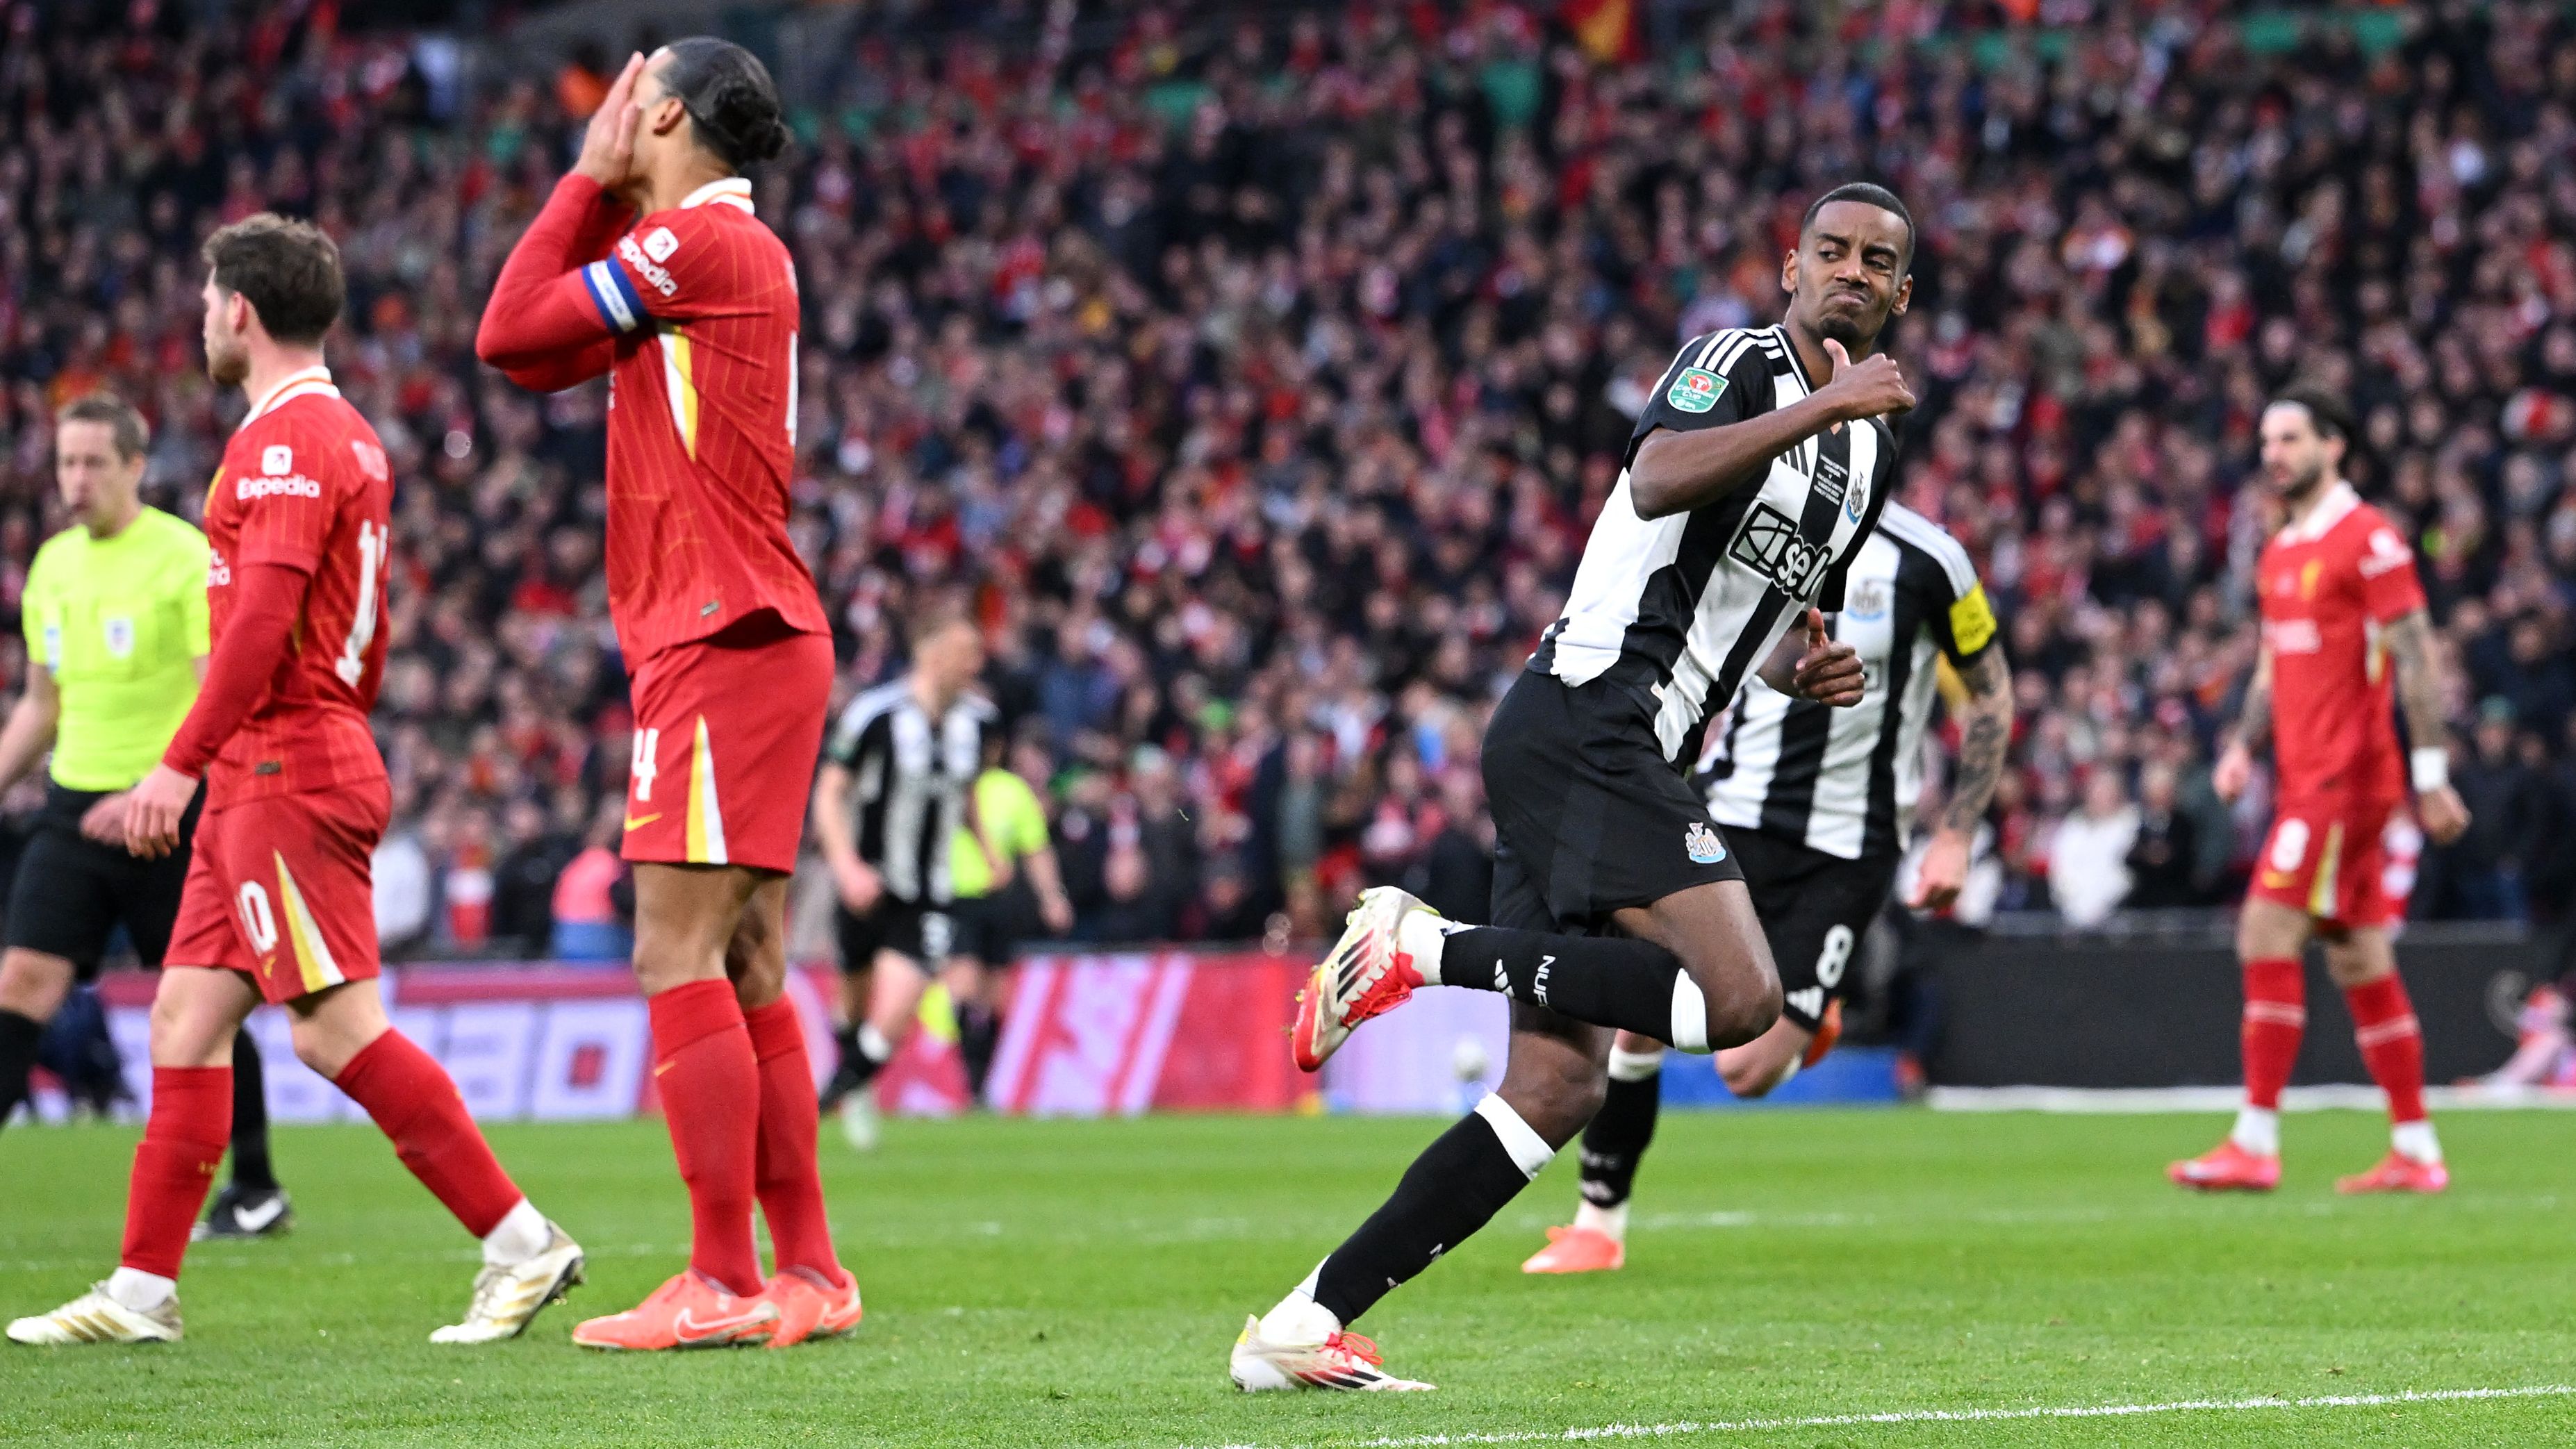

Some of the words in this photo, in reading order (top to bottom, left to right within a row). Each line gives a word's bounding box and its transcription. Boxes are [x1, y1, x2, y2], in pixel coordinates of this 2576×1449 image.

[1777, 543, 1828, 597] sel
[335, 519, 389, 688] 1
[632, 727, 659, 801] 4
[1533, 954, 1556, 1007] NUF
[1816, 924, 1854, 988] 8
